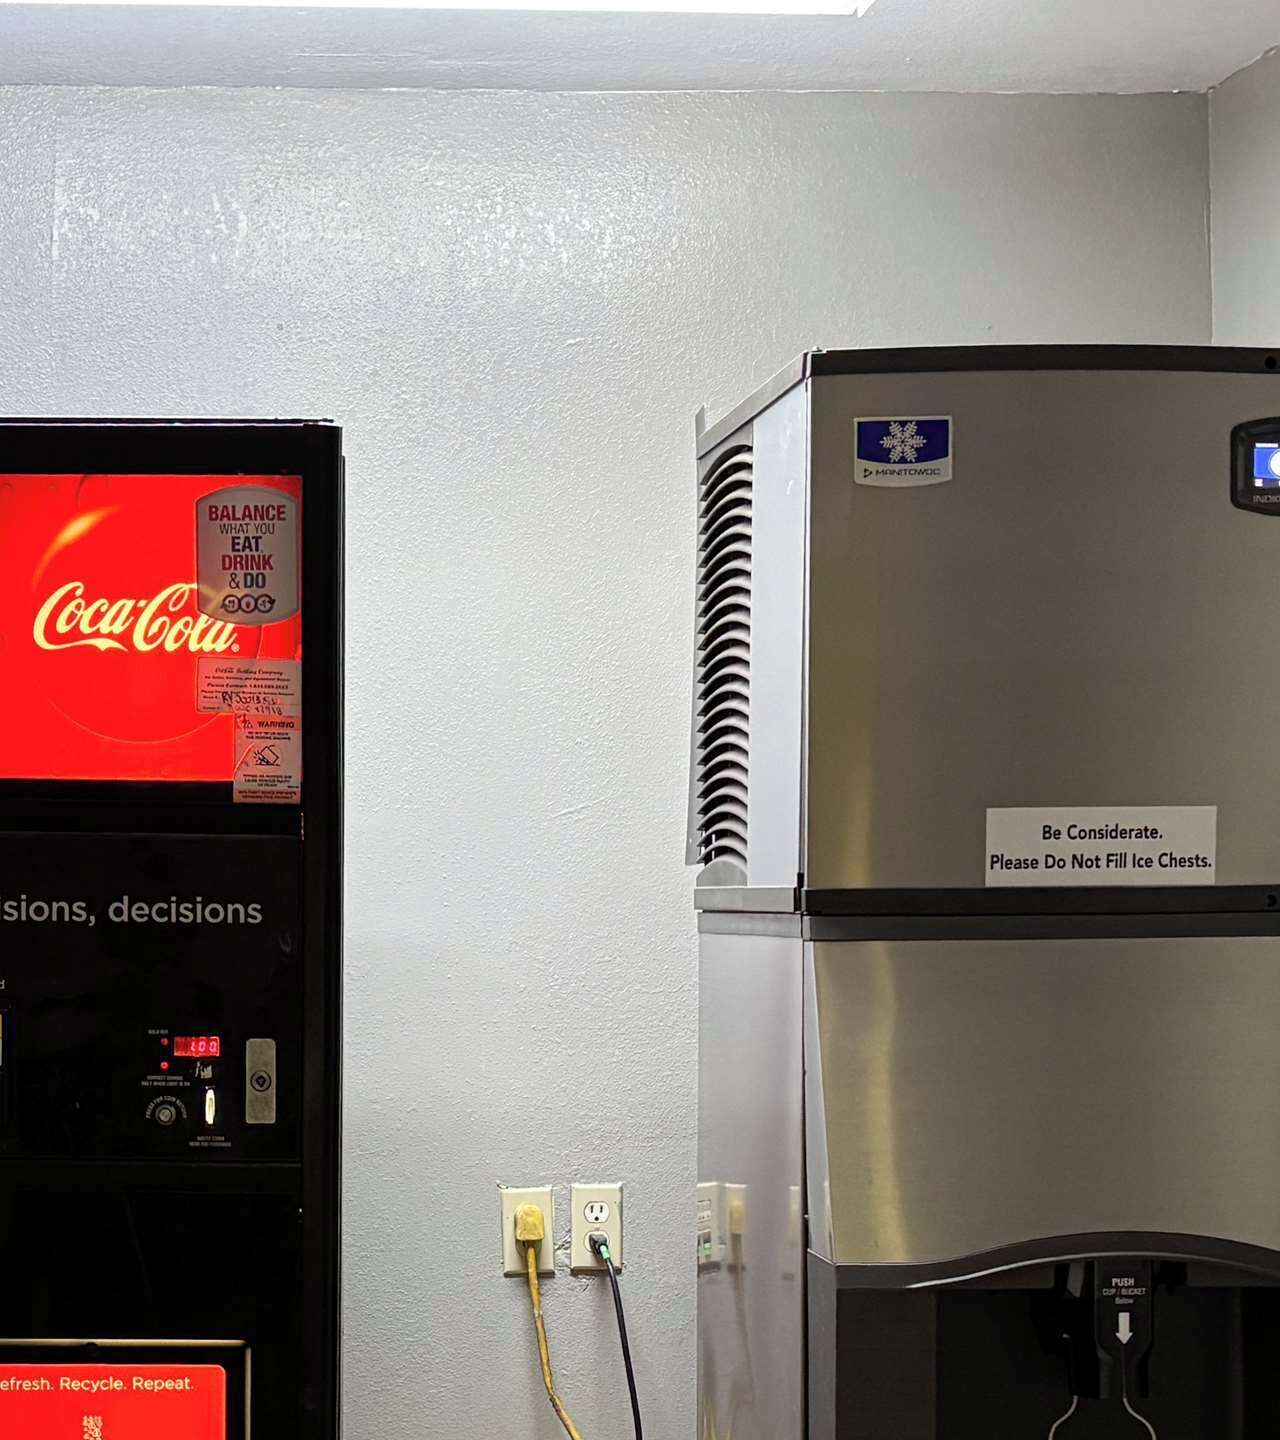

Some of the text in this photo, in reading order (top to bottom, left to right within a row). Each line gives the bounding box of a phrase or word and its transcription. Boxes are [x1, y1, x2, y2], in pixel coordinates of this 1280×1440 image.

[208, 504, 287, 522] BALANCE
[219, 522, 275, 535] WHAT YOU
[221, 554, 274, 571] DRINK
[228, 572, 266, 590] & DO
[1042, 823, 1163, 840] Be Considerate.
[990, 852, 1212, 870] Please Do Not Fill Ice Chests.
[108, 896, 263, 925] decisions
[1111, 1277, 1135, 1287] PUSH
[59, 1376, 127, 1392] Recycle.
[132, 1376, 194, 1391] Repeat.
